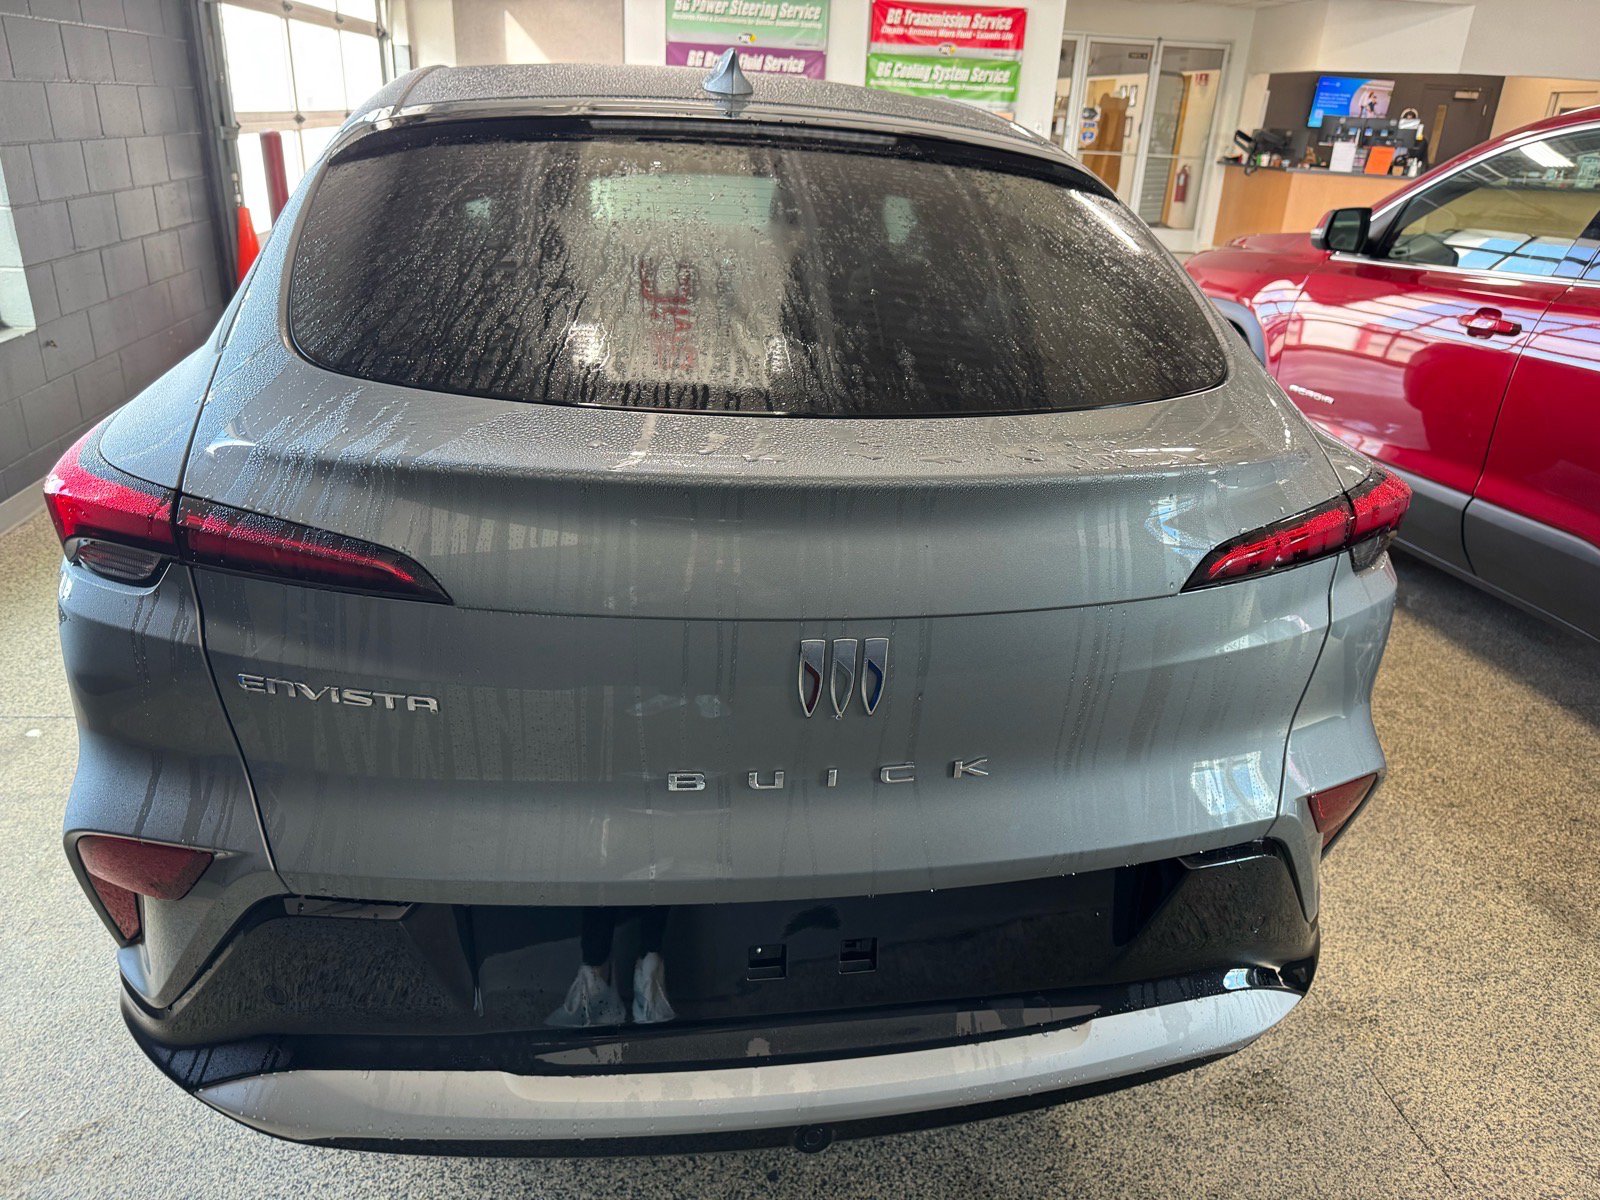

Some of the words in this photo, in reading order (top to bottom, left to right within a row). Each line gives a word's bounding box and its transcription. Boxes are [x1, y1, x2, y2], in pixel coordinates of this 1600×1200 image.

[691, 0, 729, 15] Power
[730, 0, 779, 20] Steering
[779, 3, 822, 20] Service
[886, 8, 903, 25] BG
[904, 9, 971, 28] Transmission
[972, 13, 1013, 30] Service
[687, 50, 704, 67] BG
[763, 54, 806, 73] Service
[893, 62, 932, 82] Cooling
[932, 64, 971, 83] System
[970, 66, 1012, 83] Service
[237, 673, 439, 715] ENVISTA
[667, 759, 989, 791] BUICK
